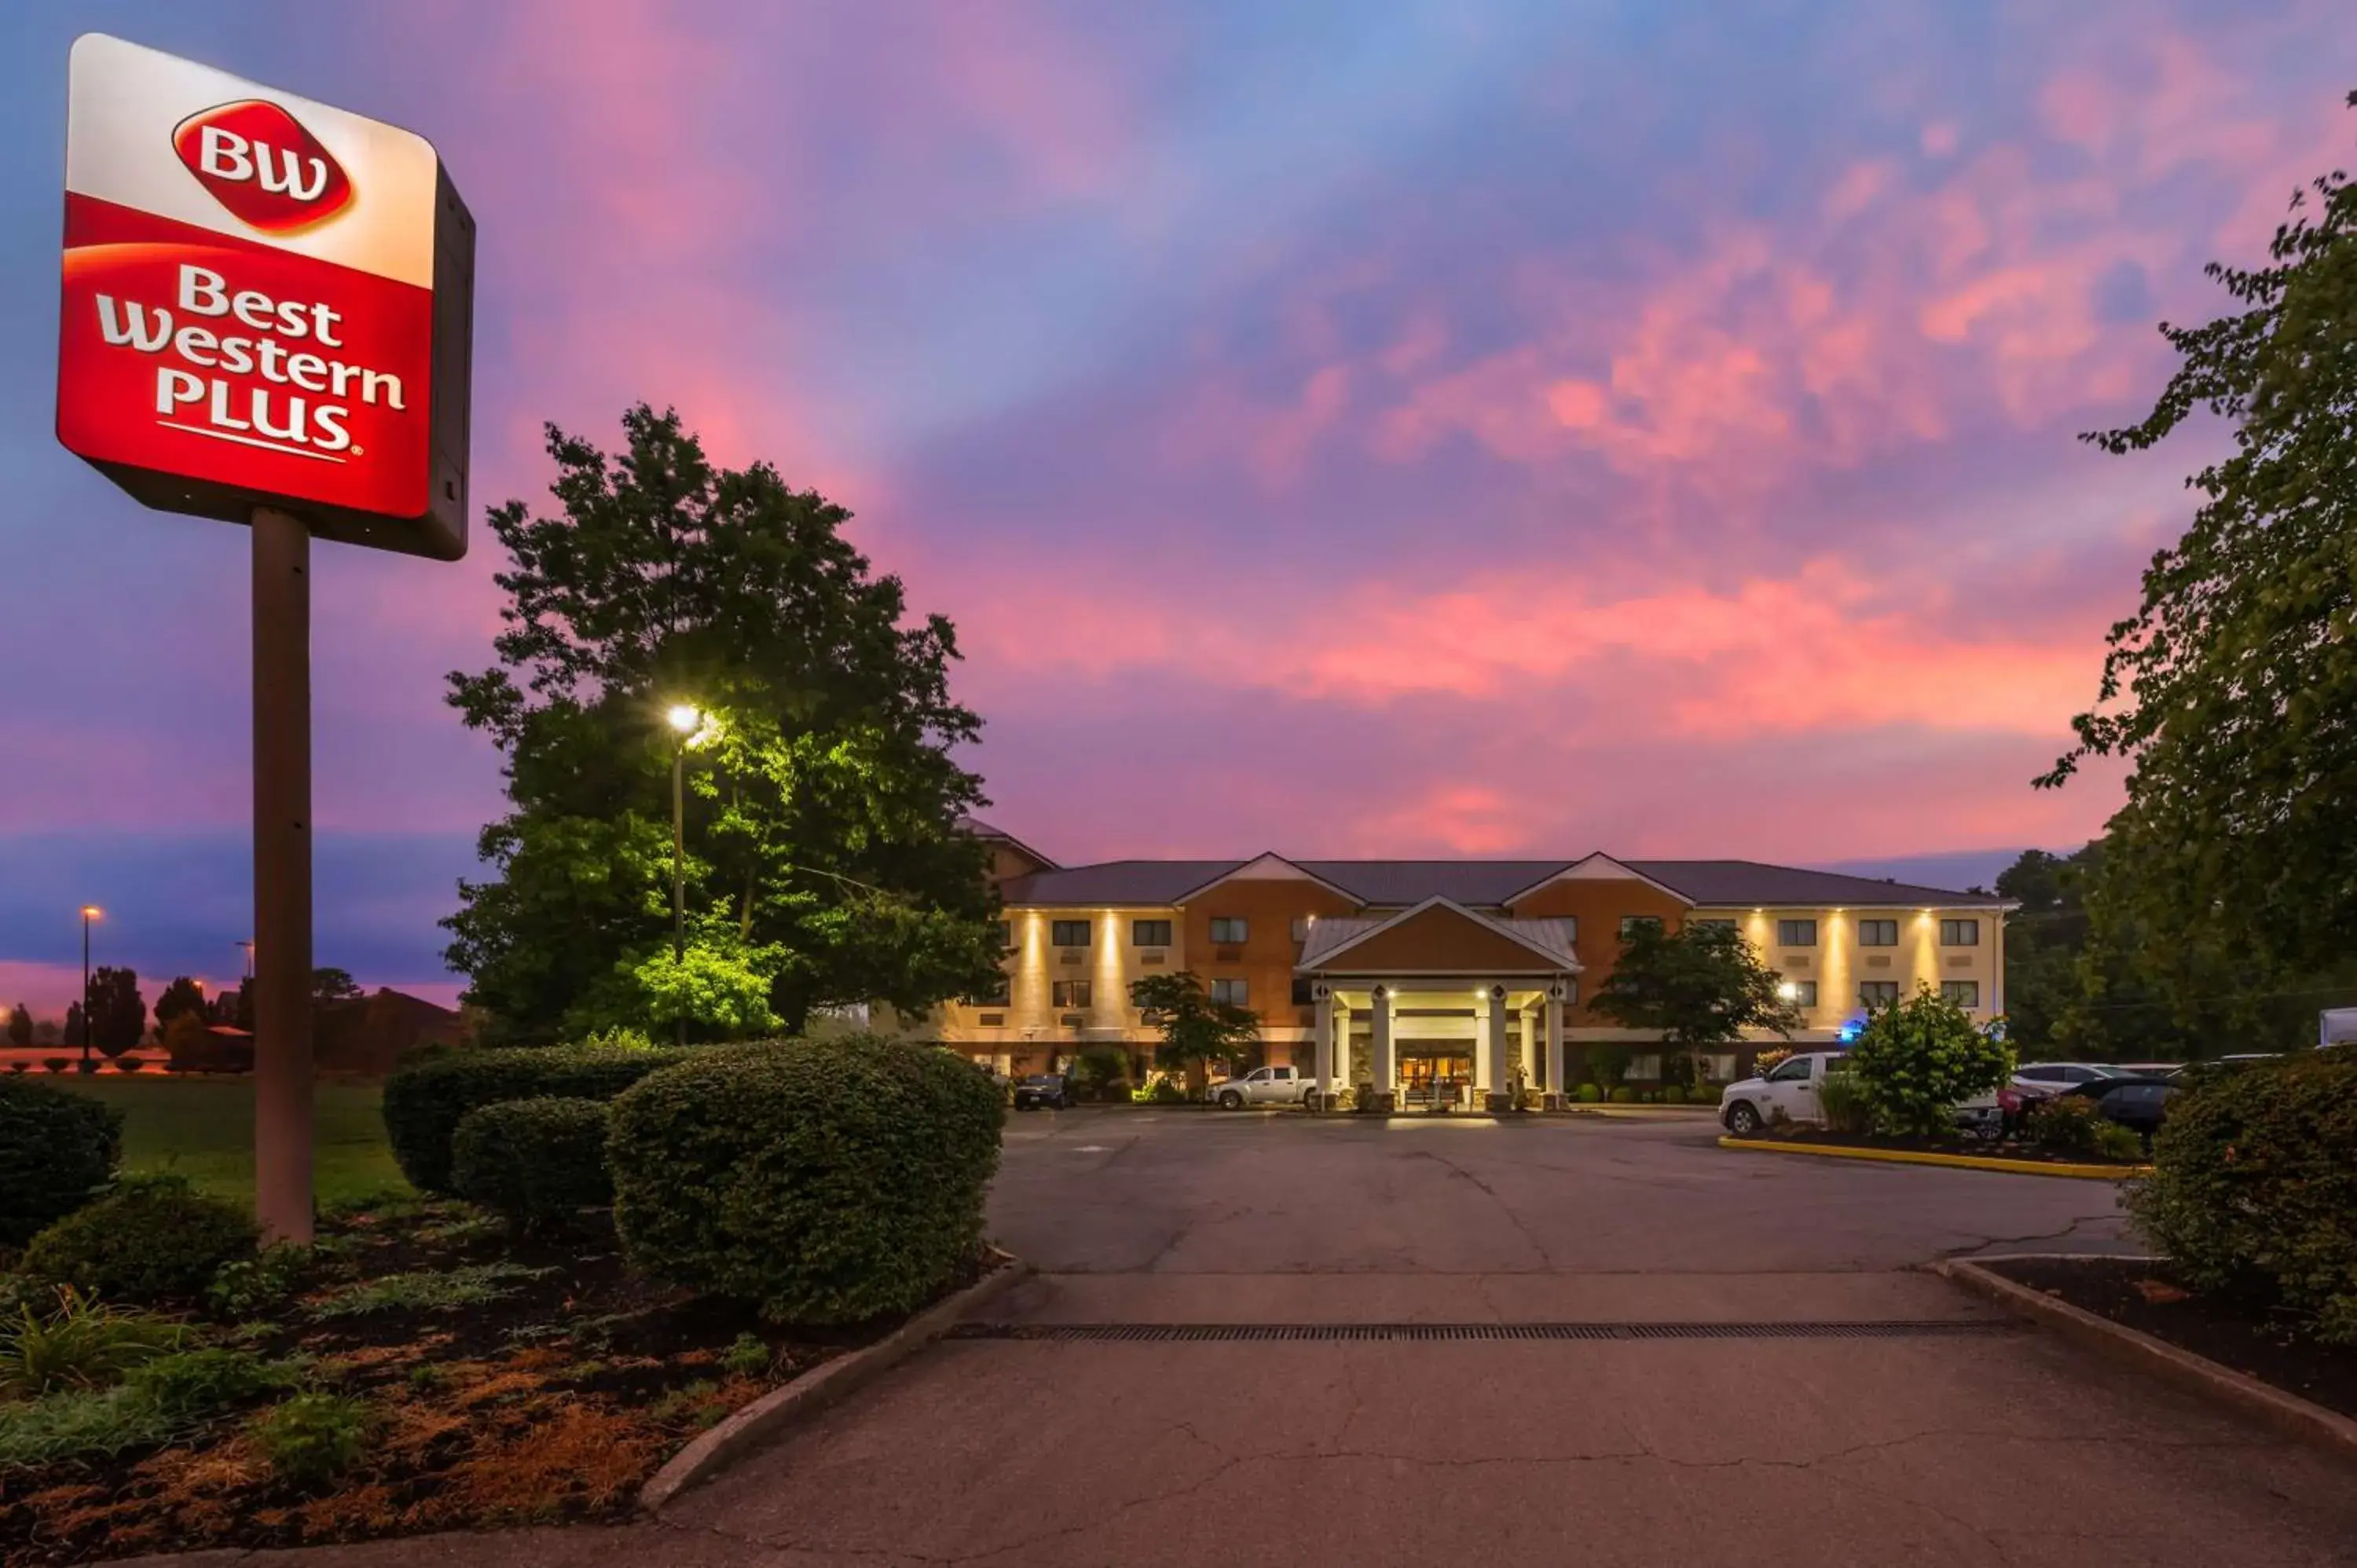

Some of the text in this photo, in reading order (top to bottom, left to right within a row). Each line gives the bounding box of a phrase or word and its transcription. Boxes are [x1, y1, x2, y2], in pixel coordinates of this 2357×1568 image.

[200, 125, 328, 201] BW
[178, 263, 343, 348] Best
[95, 293, 406, 409] Western
[156, 366, 351, 452] PLUS
